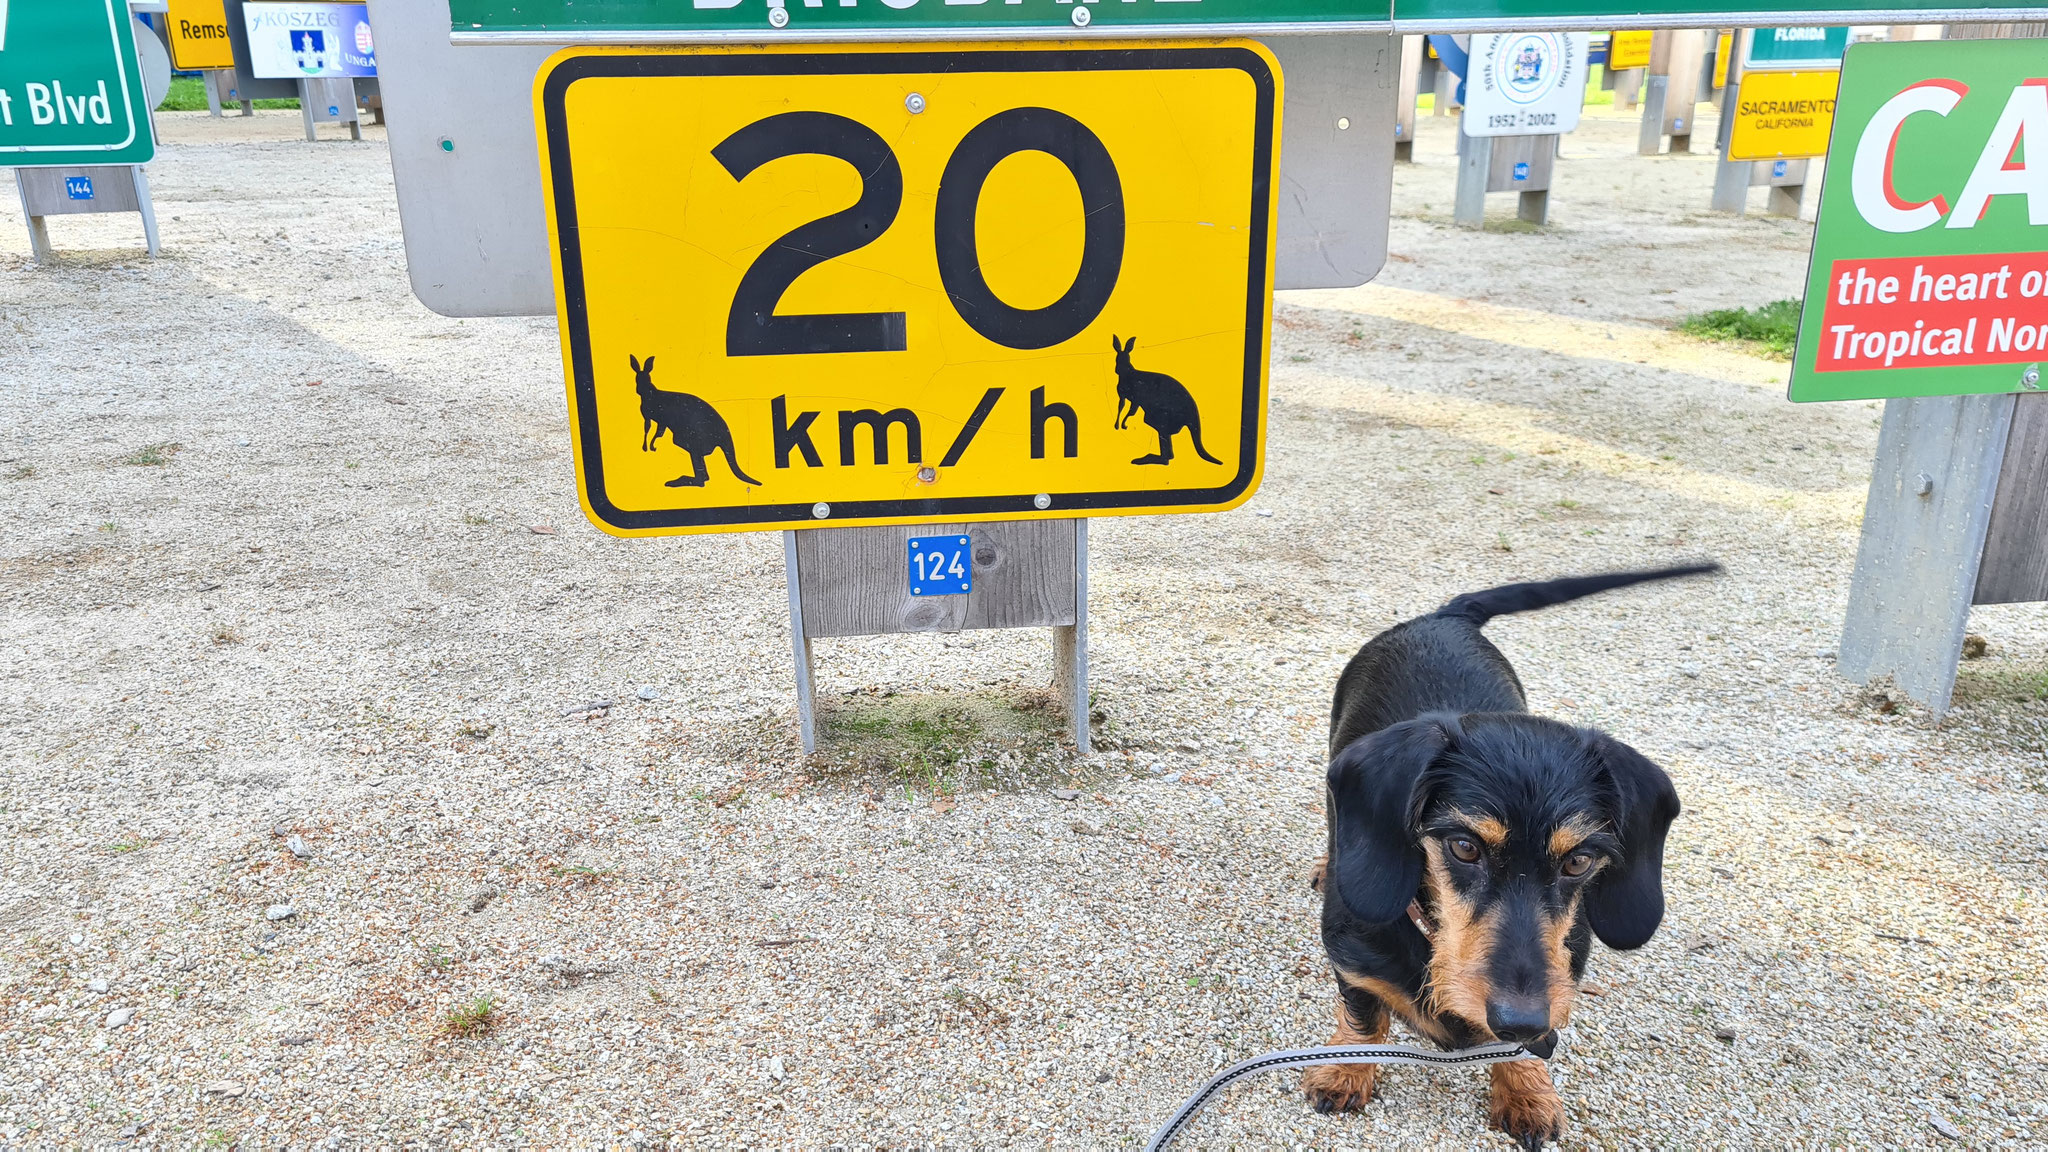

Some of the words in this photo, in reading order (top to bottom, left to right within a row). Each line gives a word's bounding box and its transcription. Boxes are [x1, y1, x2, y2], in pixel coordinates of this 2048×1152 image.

[1774, 27, 1826, 41] FLORIDA
[26, 80, 112, 125] Blvd
[1740, 99, 1836, 116] SACRAMENTO
[1488, 115, 1515, 128] 1952
[1527, 113, 1556, 126] 2002
[1756, 118, 1814, 130] CALIFORNIA
[68, 182, 91, 194] 144
[711, 106, 1125, 357] 20
[1837, 267, 1900, 306] the
[1909, 265, 2012, 302] heart
[1830, 317, 1978, 367] Tropical
[773, 385, 1079, 470] km/h
[913, 550, 966, 582] 124
